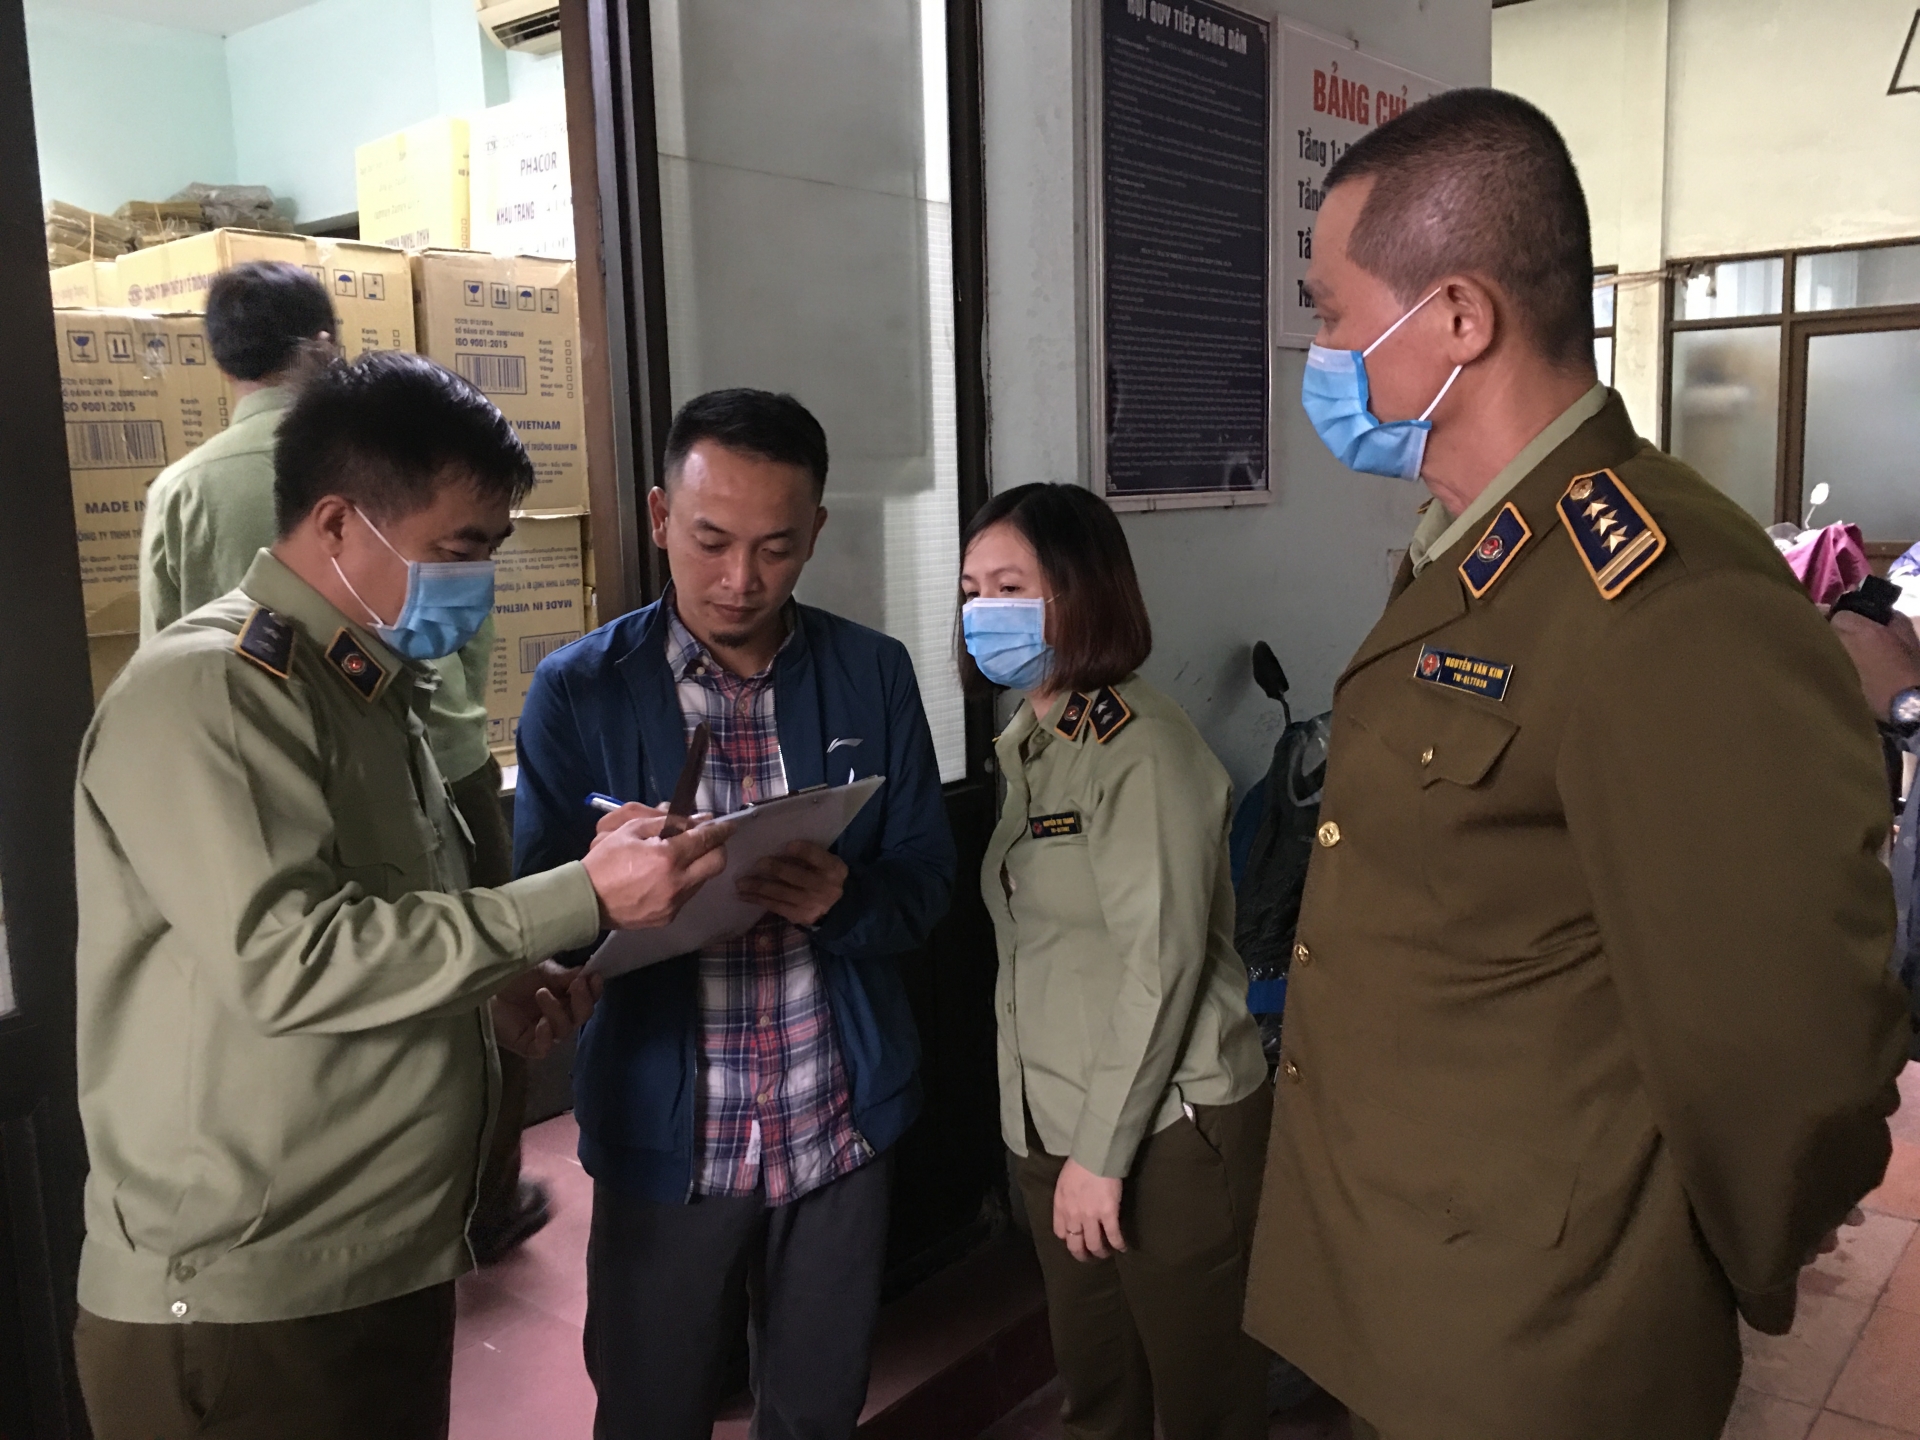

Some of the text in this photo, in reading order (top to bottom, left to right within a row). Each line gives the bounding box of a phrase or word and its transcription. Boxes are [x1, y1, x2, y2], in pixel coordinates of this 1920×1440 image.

[1150, 0, 1171, 27] QUY
[1173, 5, 1195, 35] TIẾP
[1198, 17, 1225, 47] CÔNG
[1228, 28, 1247, 55] DÂN
[1313, 60, 1369, 126] BẢNG
[520, 151, 557, 176] PHACOR
[513, 200, 535, 223] TRANG
[455, 338, 508, 349] ISO 9001:2015
[63, 401, 136, 412] SO 9001:2015
[516, 420, 561, 430] VIETNAM
[85, 501, 130, 514] MADE
[493, 599, 573, 614] MADE IN VIETNA
[1473, 661, 1488, 676] VĂN
[1488, 666, 1504, 680] KIM
